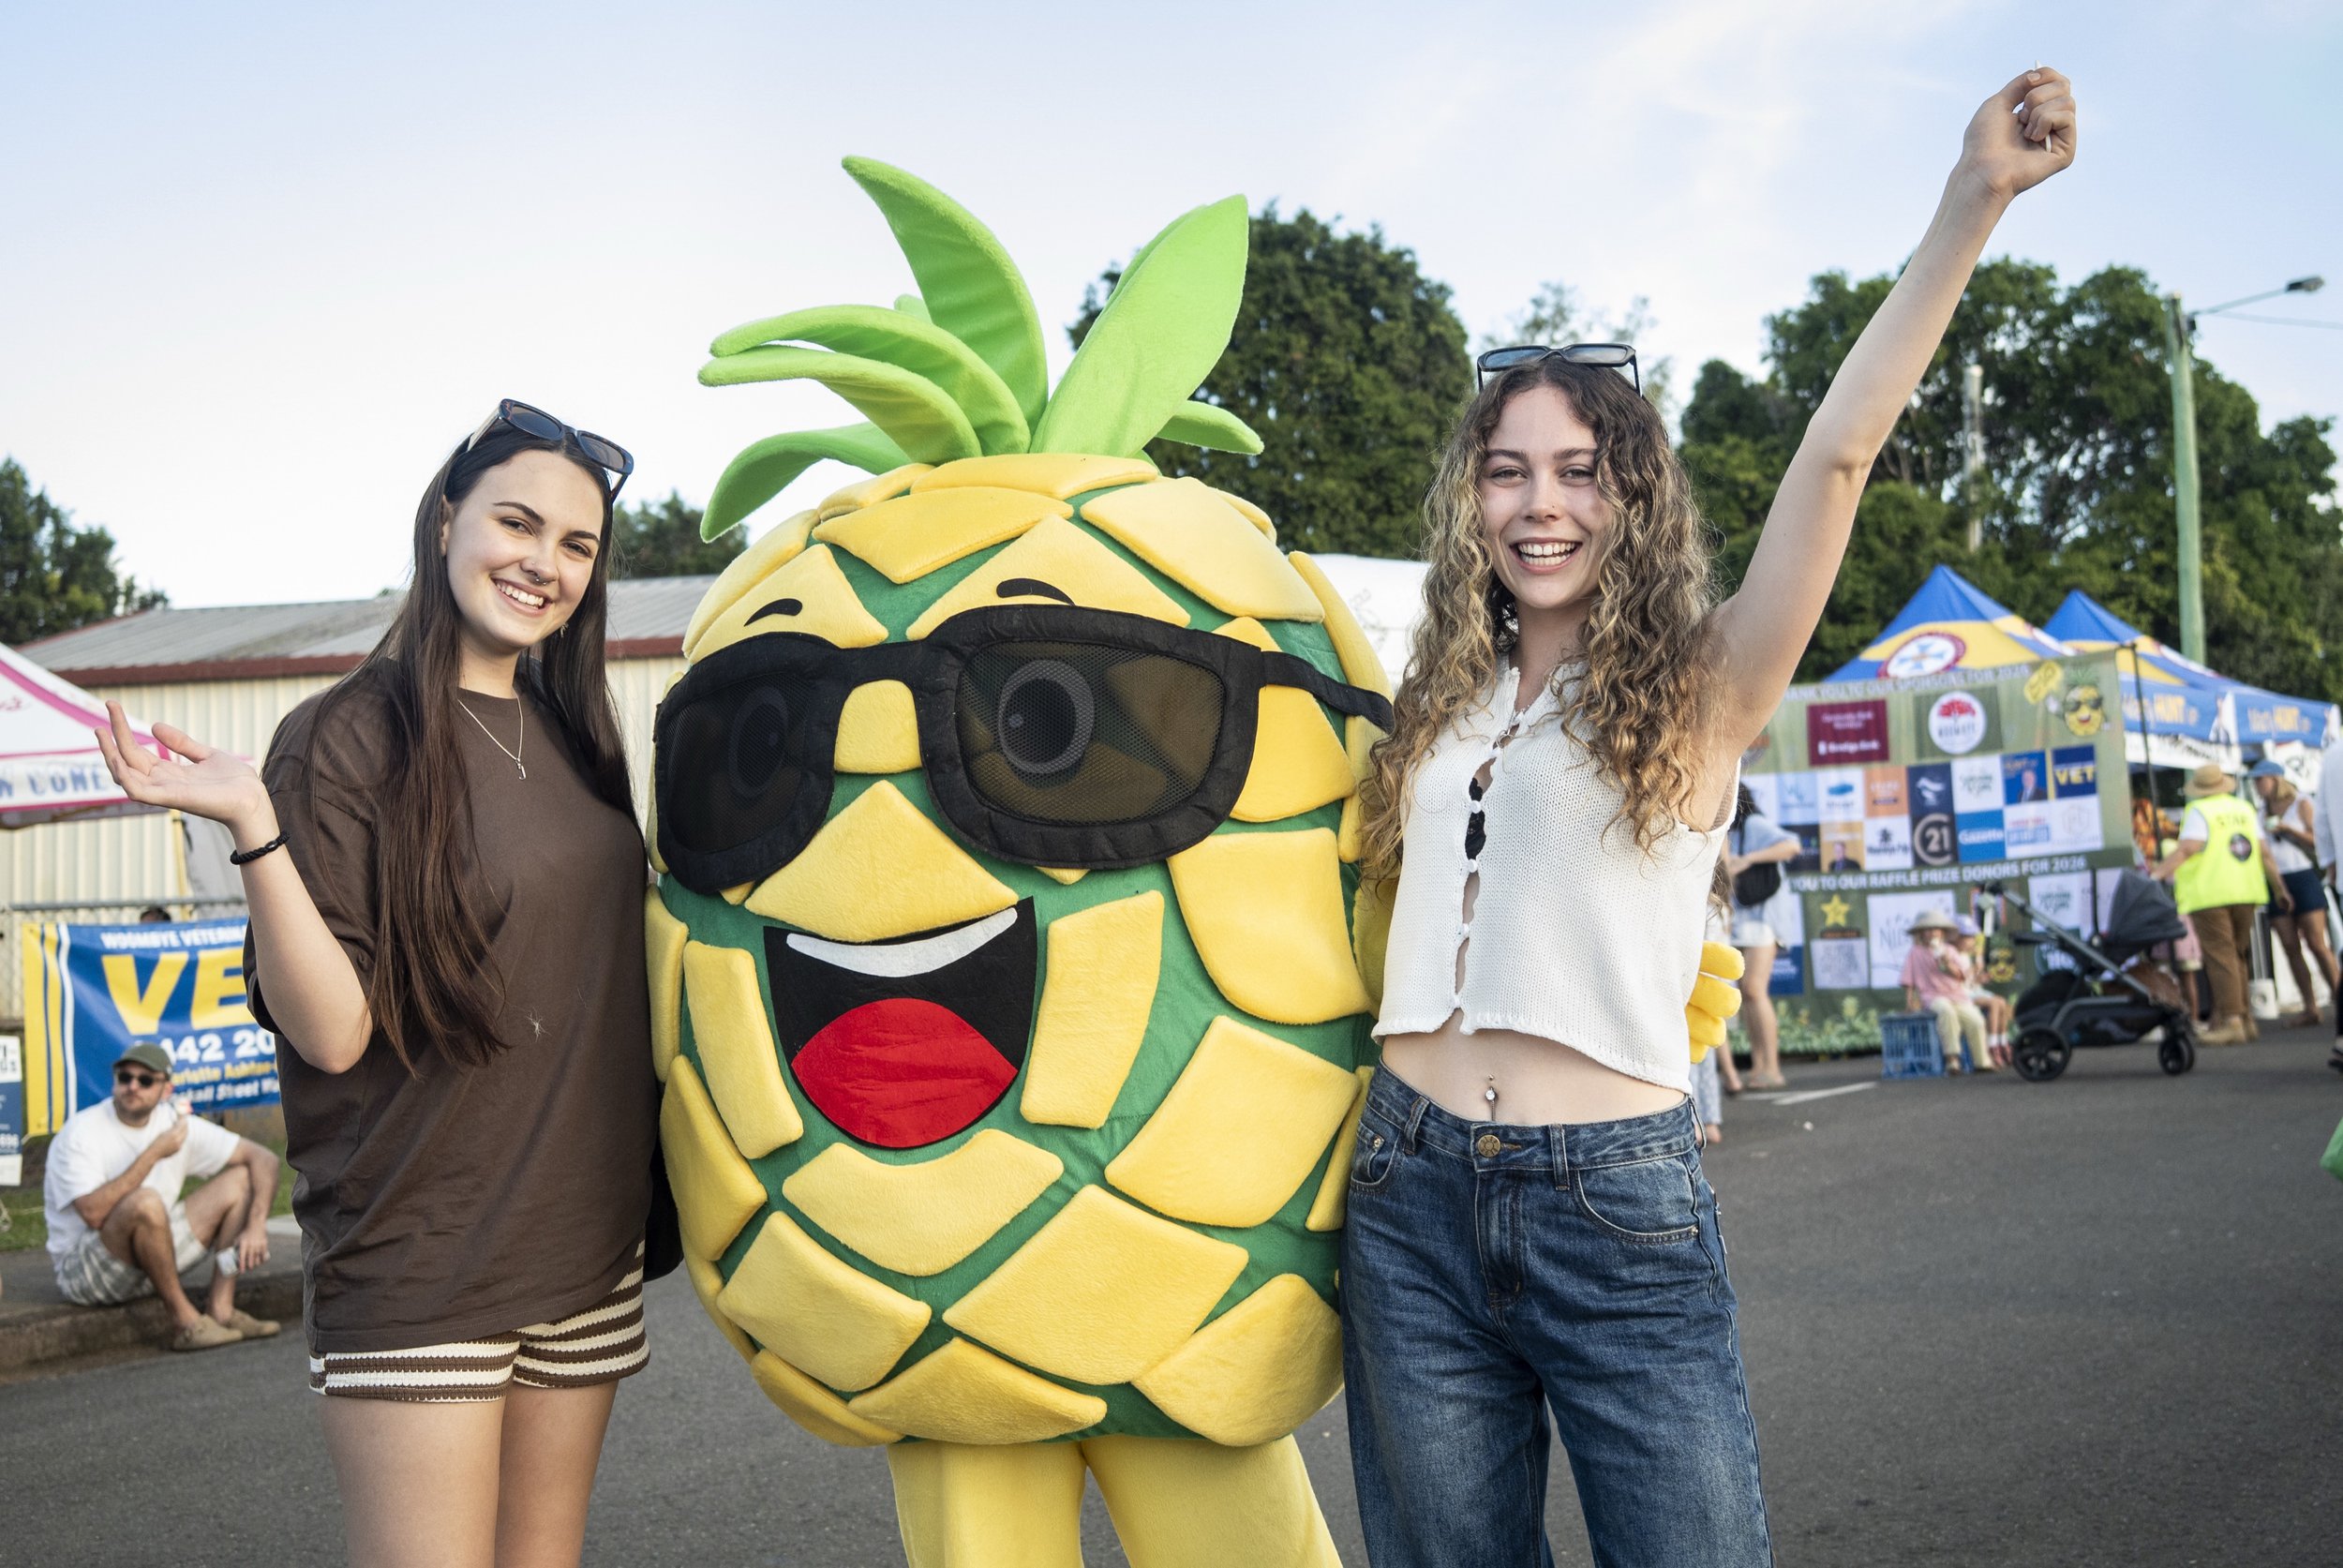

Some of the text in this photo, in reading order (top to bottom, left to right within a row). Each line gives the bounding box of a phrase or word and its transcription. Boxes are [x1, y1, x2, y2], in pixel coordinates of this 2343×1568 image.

[1784, 686, 1815, 700] HANK
[1968, 669, 1993, 683] FOR
[2054, 765, 2095, 785] VET
[1959, 829, 2004, 844] Gazette
[1791, 855, 2087, 891] YOU TO OUR RAFFLE PRIZE DONORS FOR 2026
